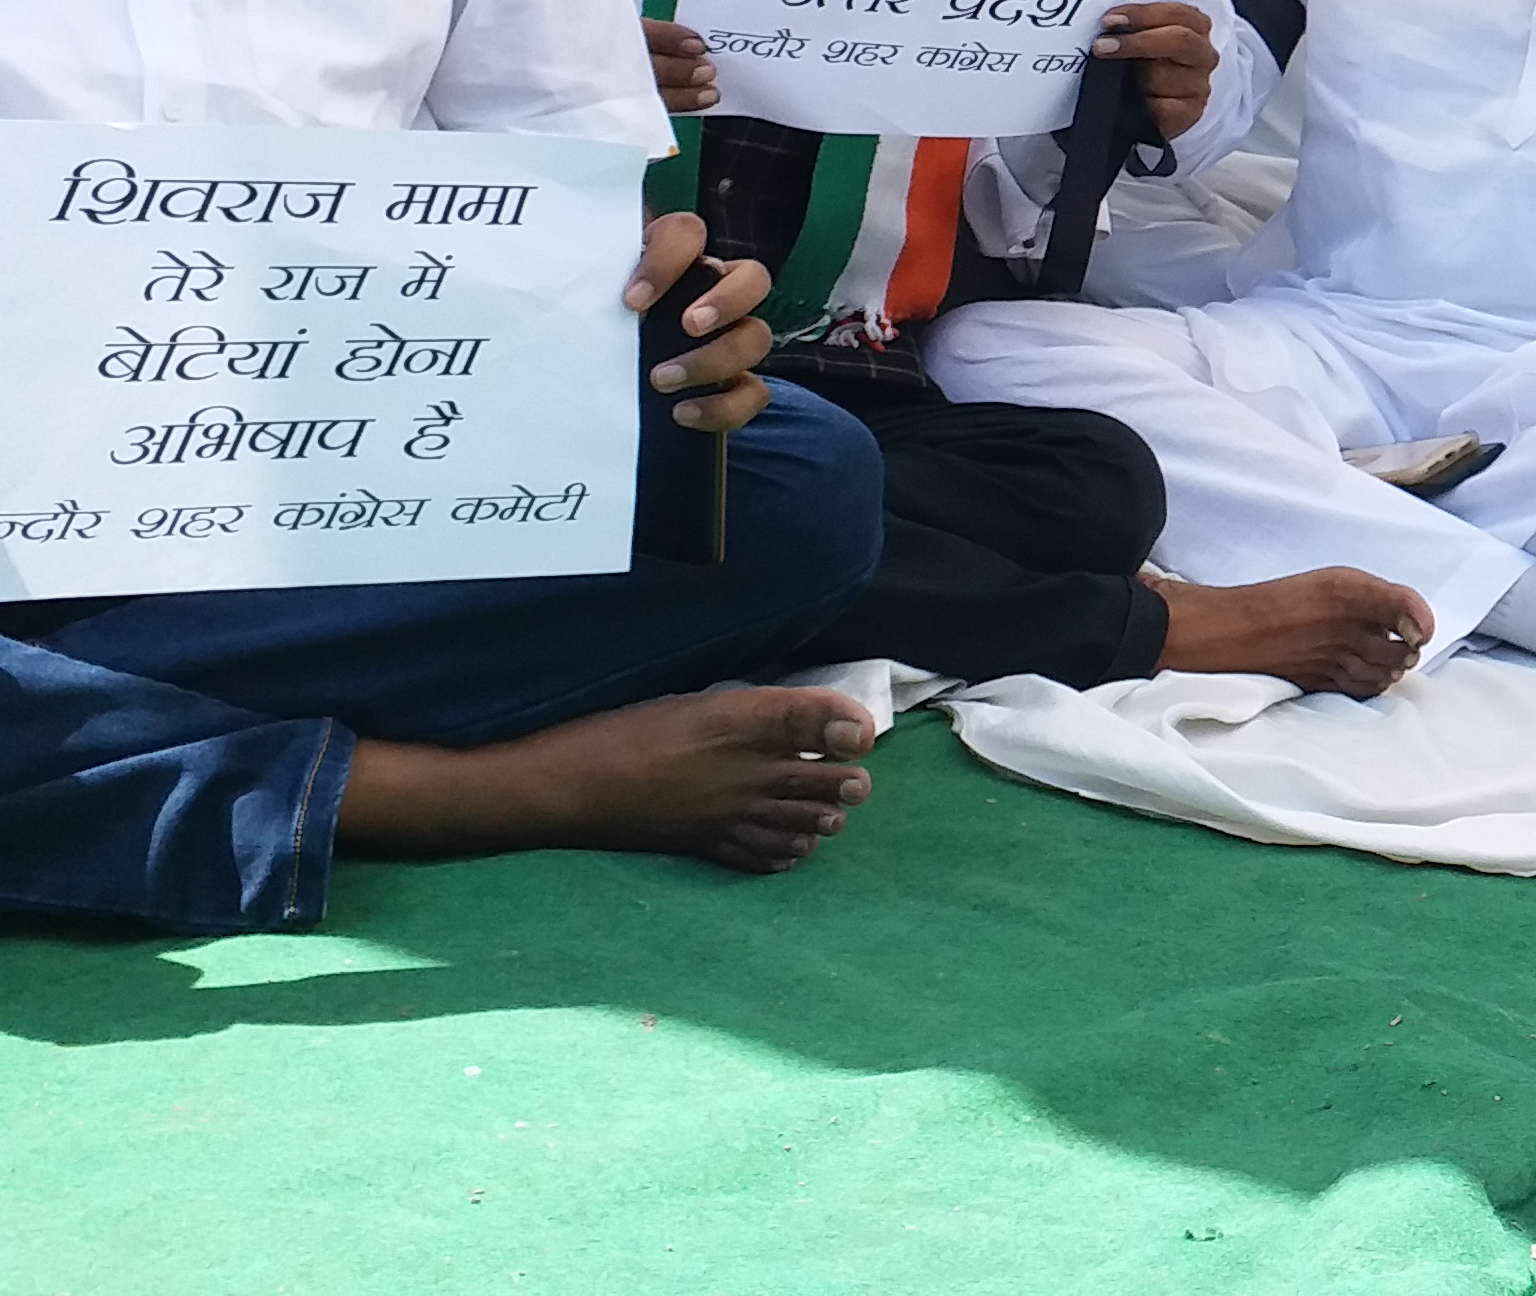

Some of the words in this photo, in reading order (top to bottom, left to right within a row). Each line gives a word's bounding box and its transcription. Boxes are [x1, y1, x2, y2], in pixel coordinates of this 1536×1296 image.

[703, 27, 811, 62] इन्दौर
[822, 39, 904, 67] शहर
[916, 41, 1023, 74] कांग्रेस
[1032, 47, 1090, 76] कमे
[49, 158, 356, 226] शिवराज
[385, 181, 538, 227] मामा
[142, 250, 235, 303] तेरे
[259, 264, 378, 302] राज
[400, 250, 455, 300] में
[98, 325, 310, 383] बेटियां
[335, 323, 489, 382] होना
[110, 404, 376, 466] अभिषाप
[403, 400, 464, 461] है
[0, 498, 111, 544] न्दौर
[129, 504, 253, 540] शहर
[273, 489, 432, 533] कांग्रेस
[450, 482, 590, 525] कमेटी
